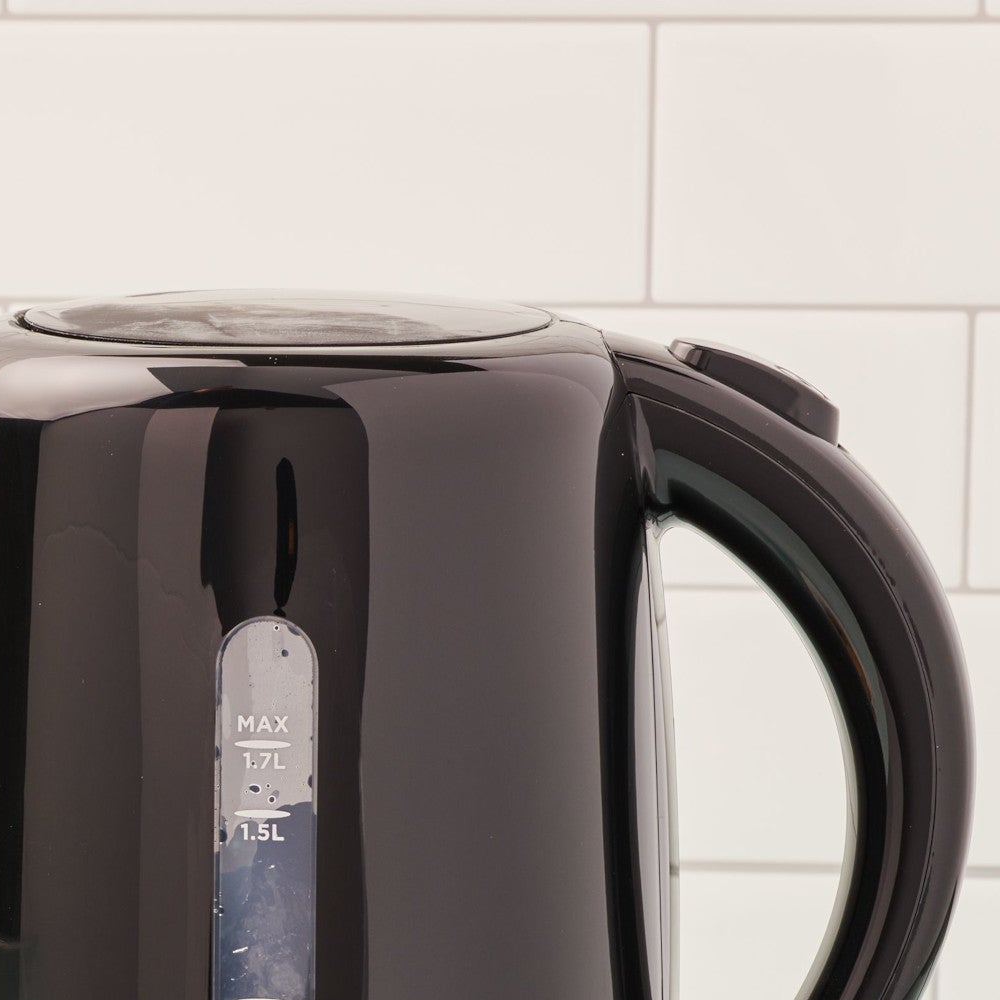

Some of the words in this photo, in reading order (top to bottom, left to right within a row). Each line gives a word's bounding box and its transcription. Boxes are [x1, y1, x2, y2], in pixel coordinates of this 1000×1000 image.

[237, 715, 289, 733] MAX
[242, 752, 286, 770] 1.7L
[240, 823, 285, 841] 1.5L
